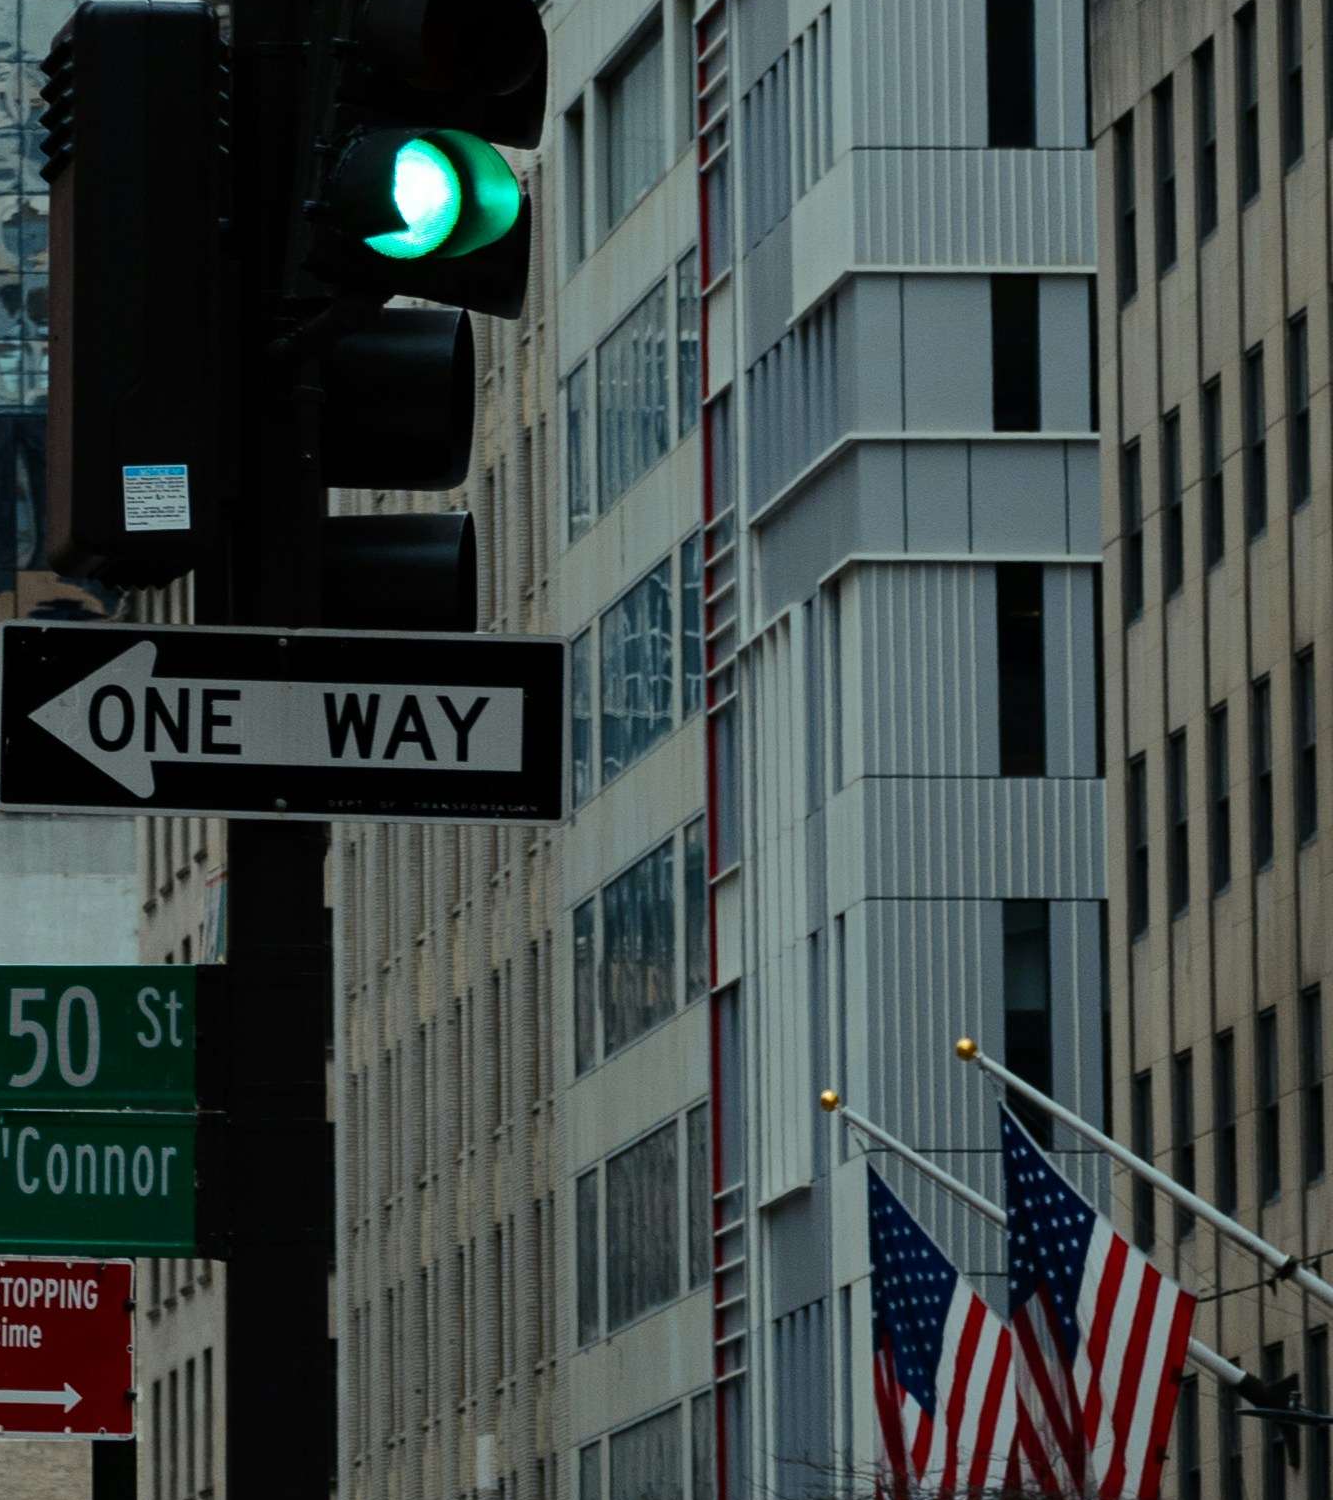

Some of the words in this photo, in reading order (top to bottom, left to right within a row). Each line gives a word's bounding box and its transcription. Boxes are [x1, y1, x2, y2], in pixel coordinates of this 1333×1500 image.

[87, 684, 241, 756] ONE
[324, 692, 490, 762] WAY
[8, 986, 100, 1089] 50
[136, 987, 183, 1048] St
